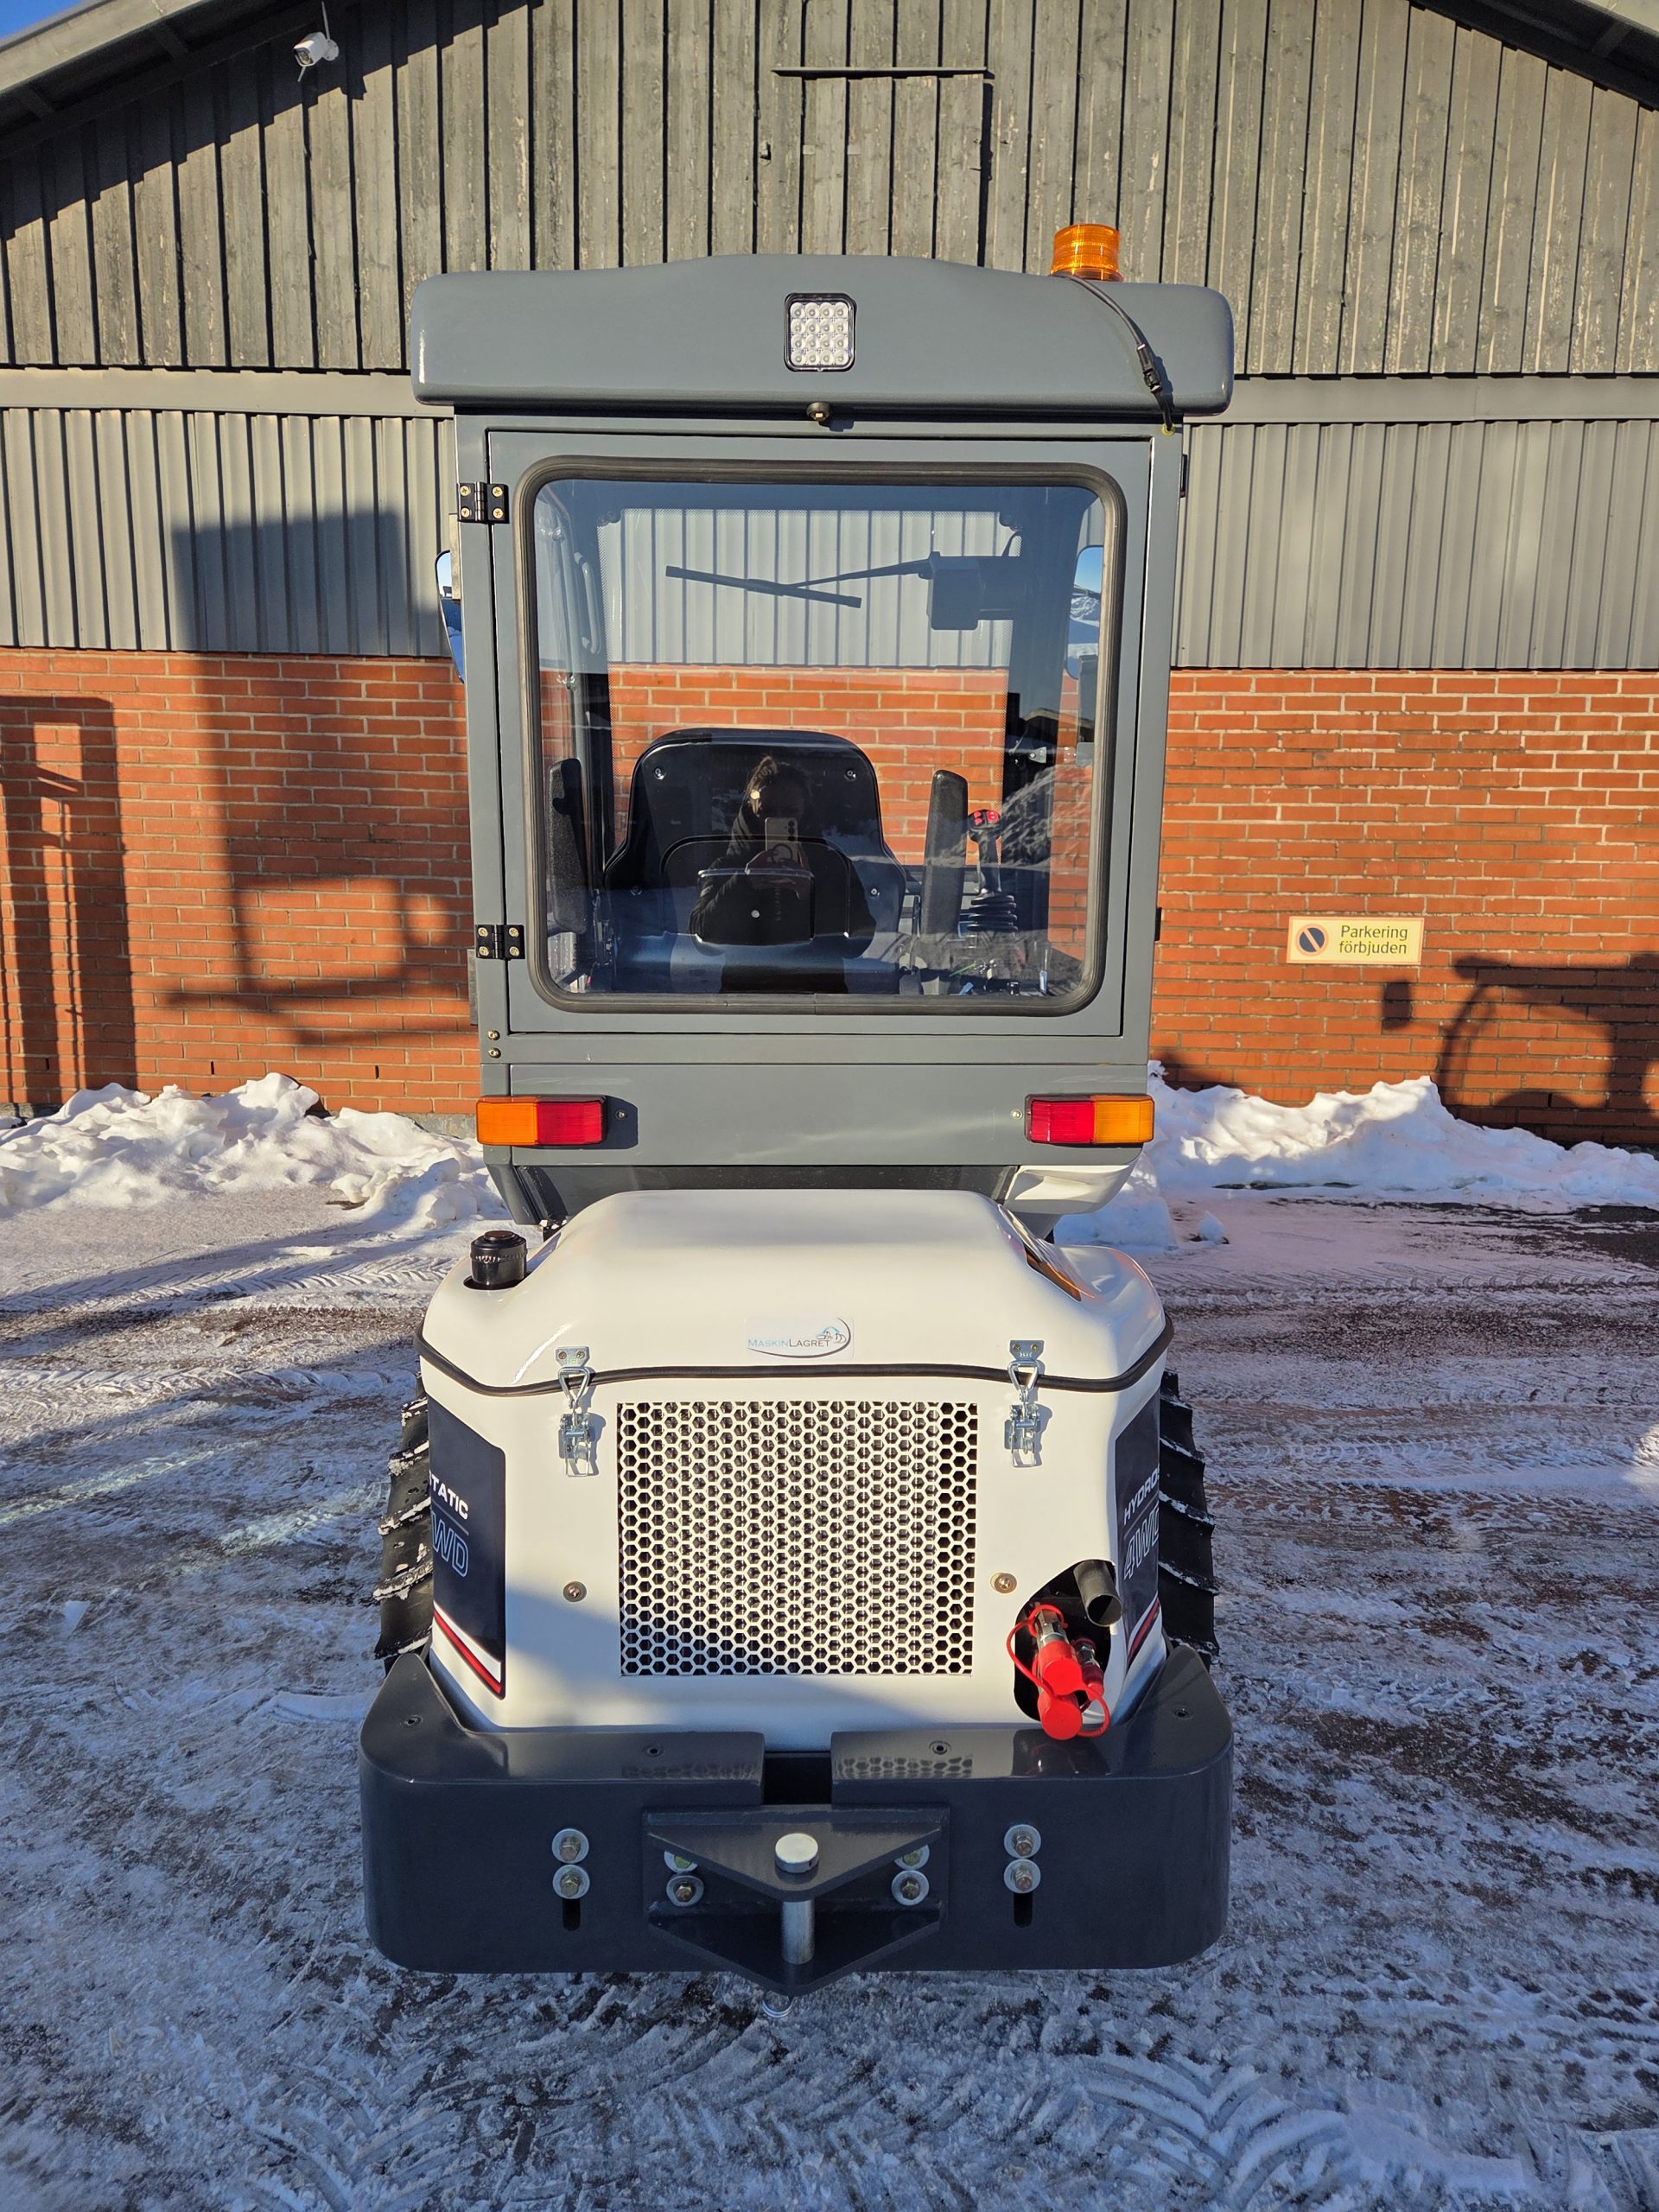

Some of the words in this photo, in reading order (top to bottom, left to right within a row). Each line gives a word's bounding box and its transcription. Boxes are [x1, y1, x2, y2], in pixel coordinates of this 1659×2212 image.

[1341, 925, 1408, 941] Parkering
[1339, 941, 1407, 956] förbjuden
[429, 1470, 468, 1520] TATIC
